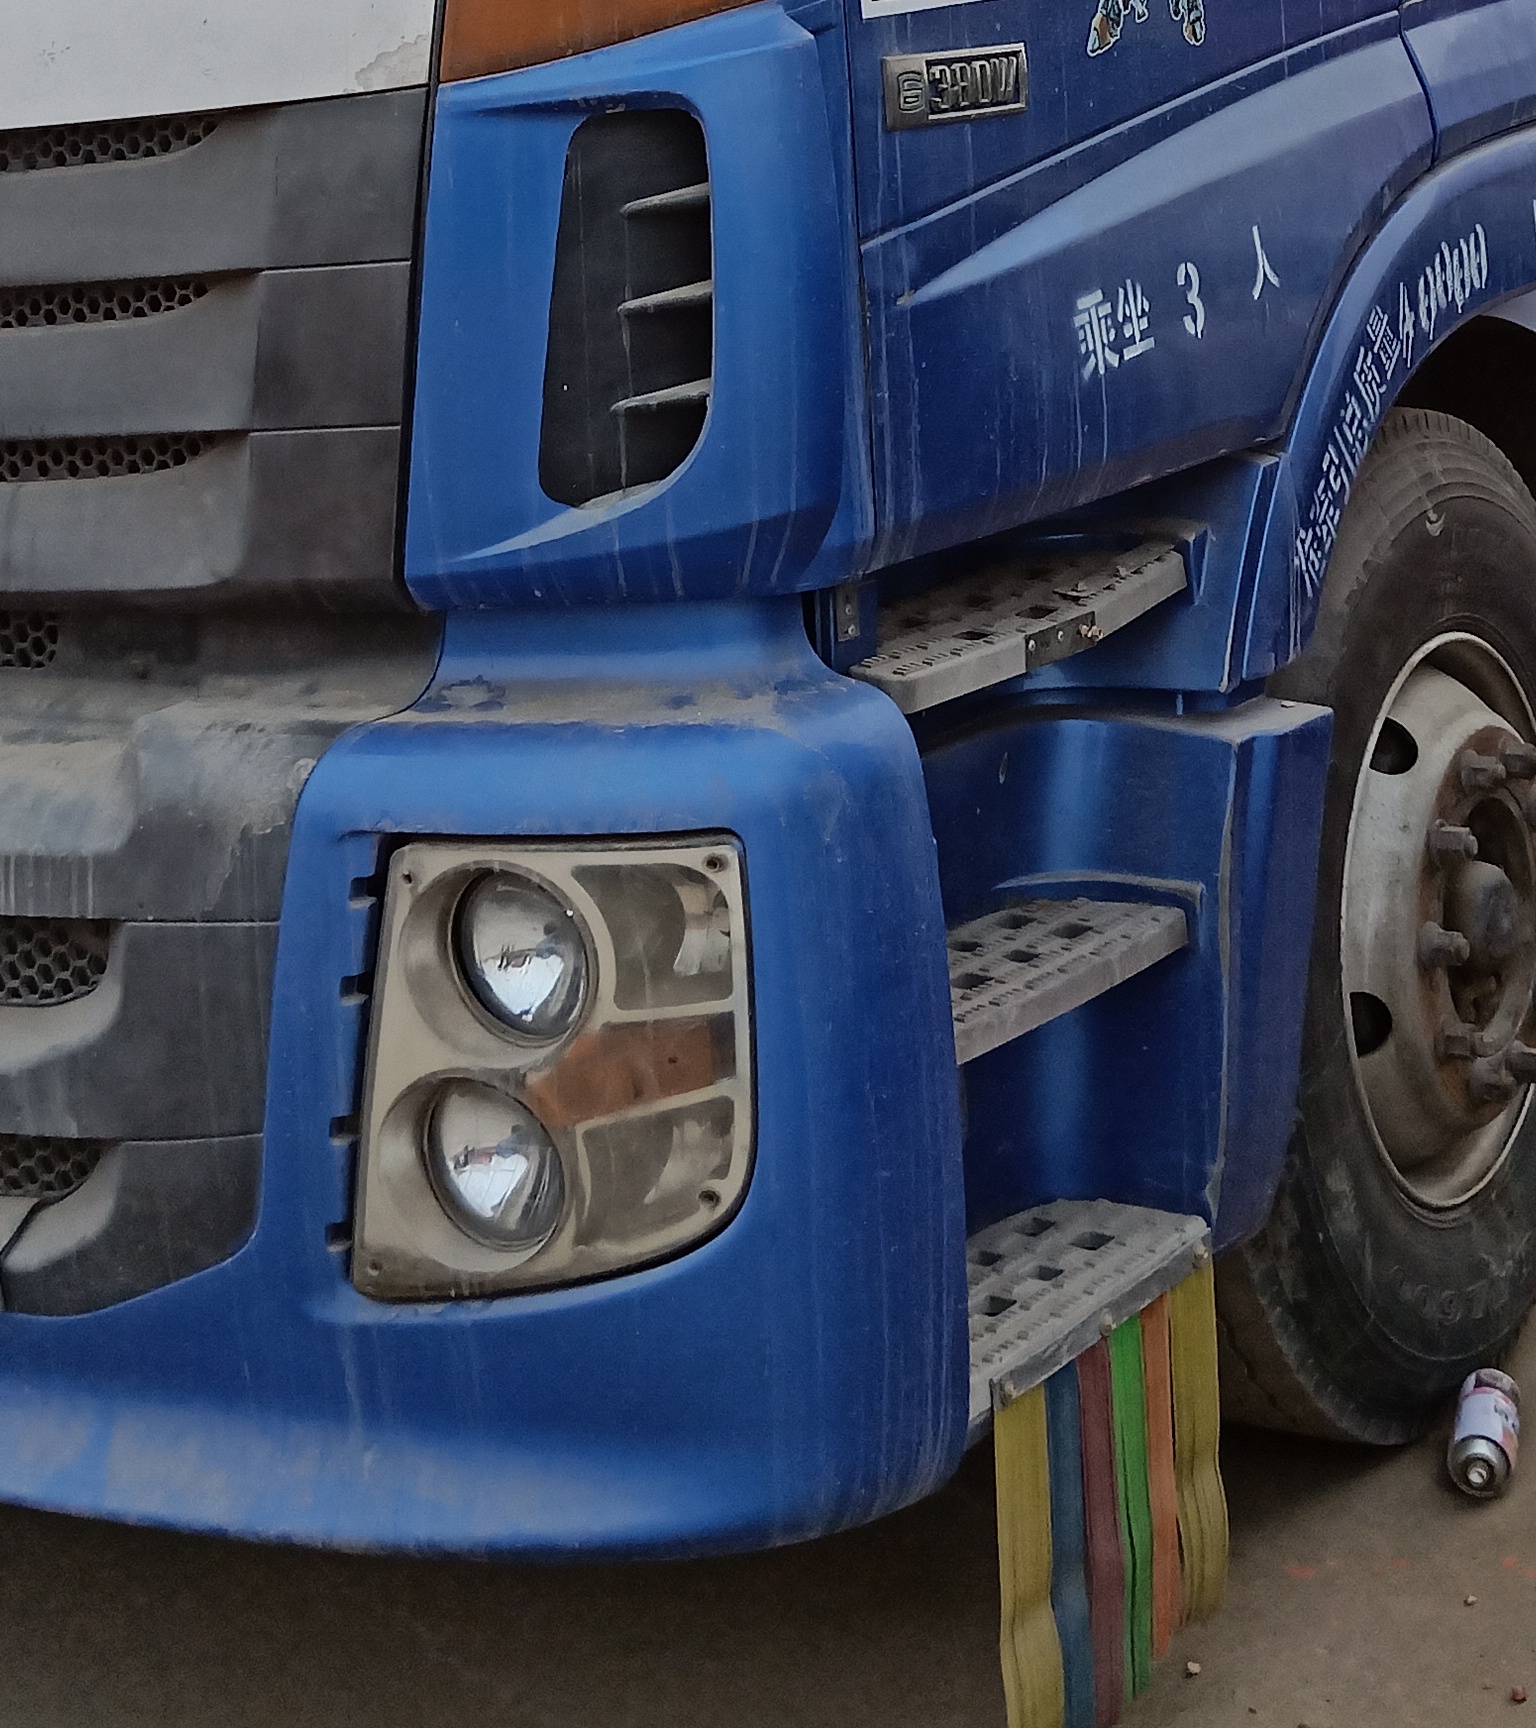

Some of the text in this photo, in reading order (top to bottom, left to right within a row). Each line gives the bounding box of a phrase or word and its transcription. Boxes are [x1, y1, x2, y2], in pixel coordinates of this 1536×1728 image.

[1073, 224, 1281, 382] 乘坐 3 人
